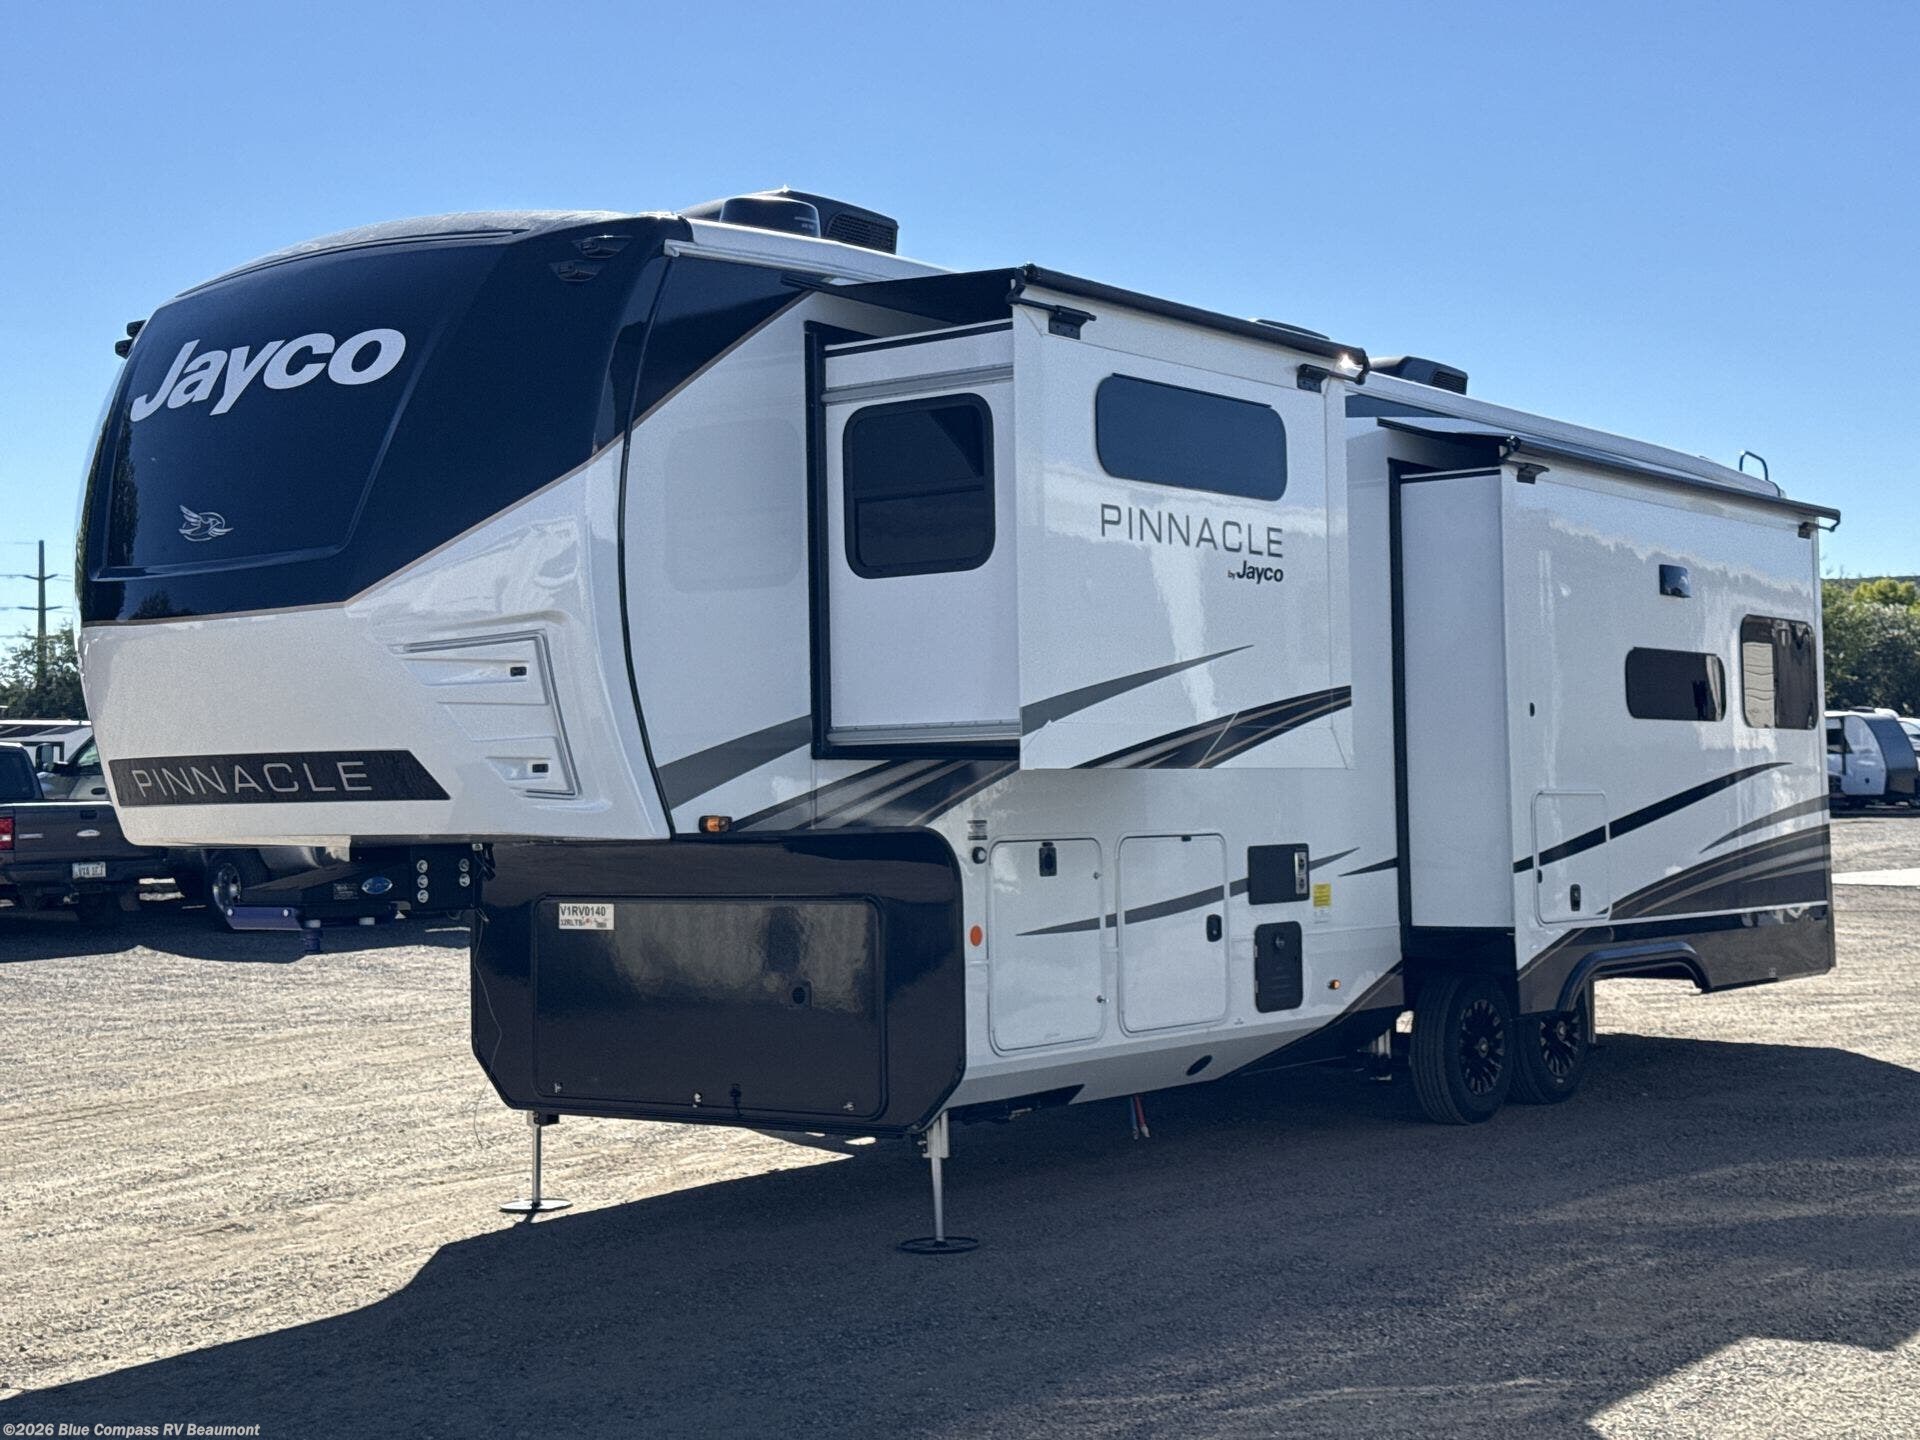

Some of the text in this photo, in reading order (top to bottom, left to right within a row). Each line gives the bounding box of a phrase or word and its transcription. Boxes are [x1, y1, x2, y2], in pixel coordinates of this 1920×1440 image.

[130, 328, 406, 422] Jayco
[1101, 503, 1283, 558] PINNACLE
[1227, 561, 1284, 584] by Jayco
[131, 761, 372, 798] PINNACLE
[560, 906, 606, 916] V1RV0140
